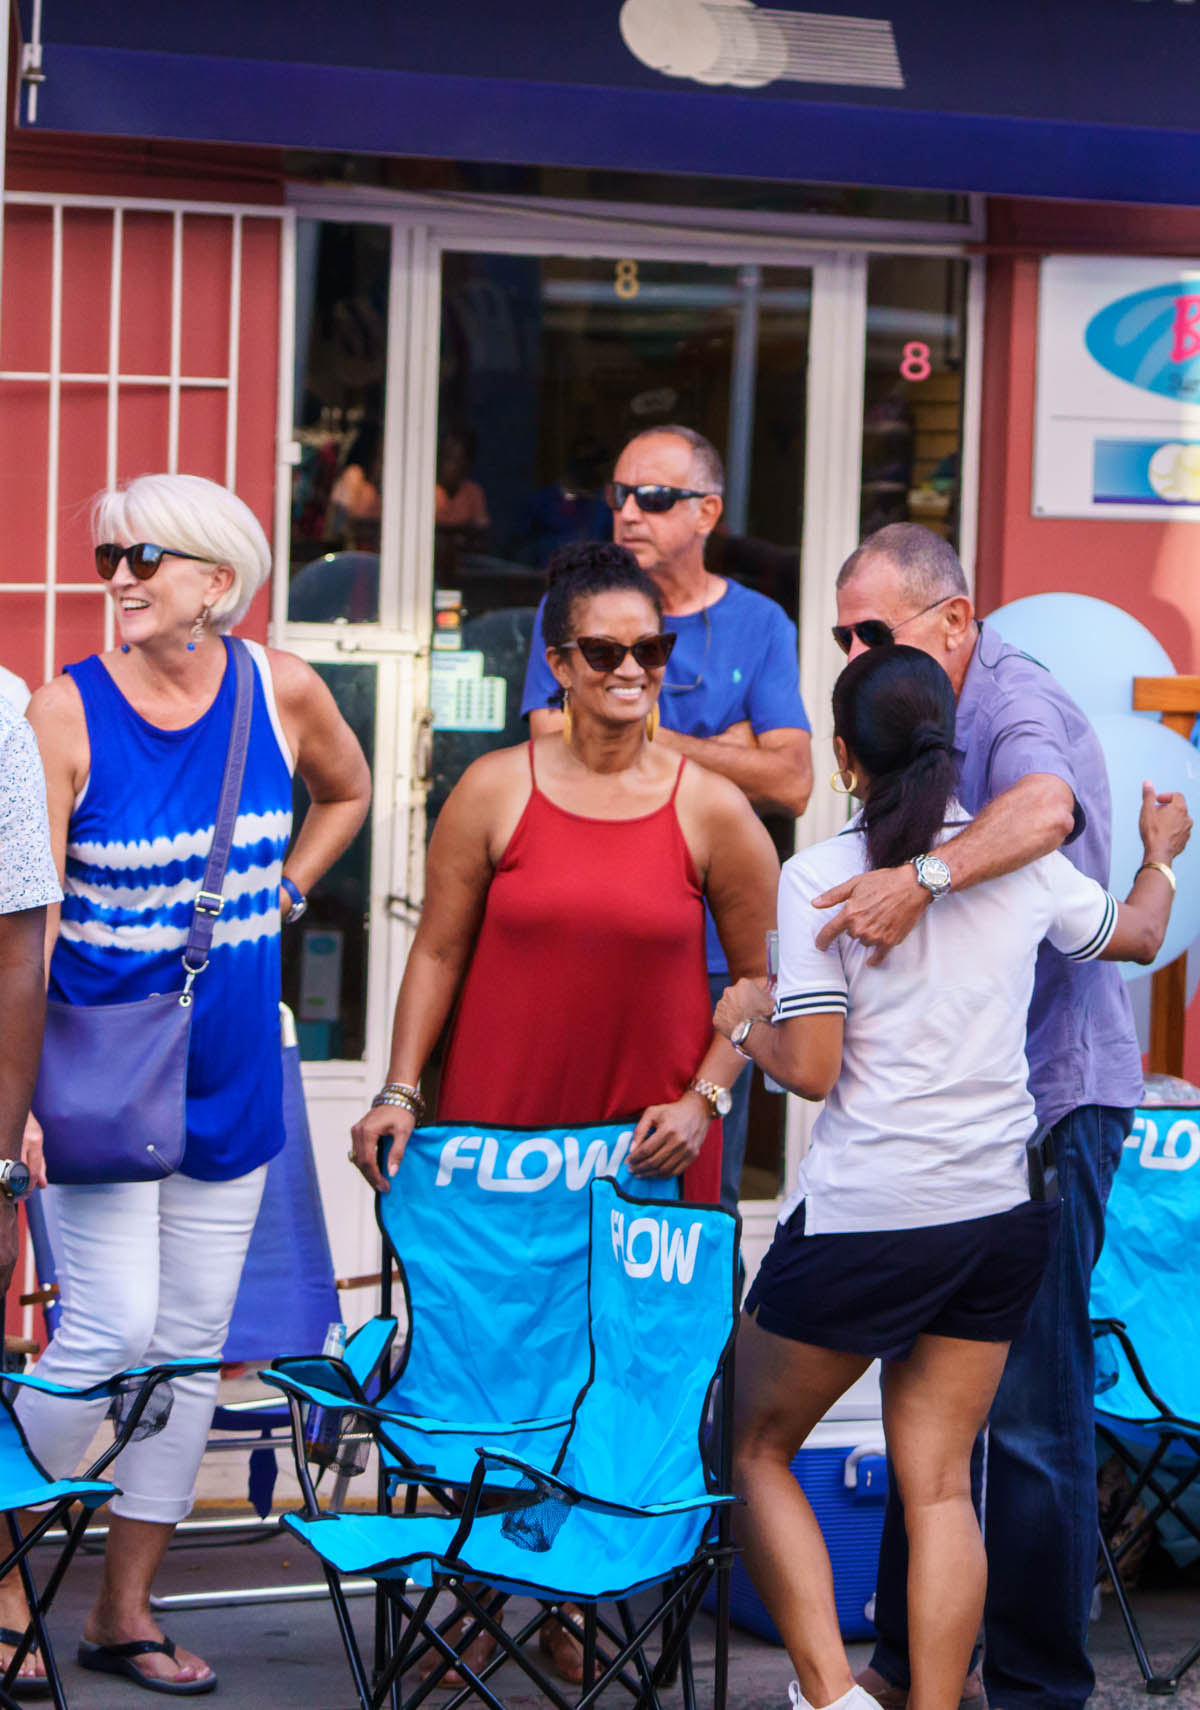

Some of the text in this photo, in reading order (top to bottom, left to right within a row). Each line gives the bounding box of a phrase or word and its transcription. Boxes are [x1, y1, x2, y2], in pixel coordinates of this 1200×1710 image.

[614, 259, 640, 299] 8
[900, 341, 932, 381] 8
[435, 1131, 634, 1192] FLOW
[611, 1208, 702, 1285] FLOW
